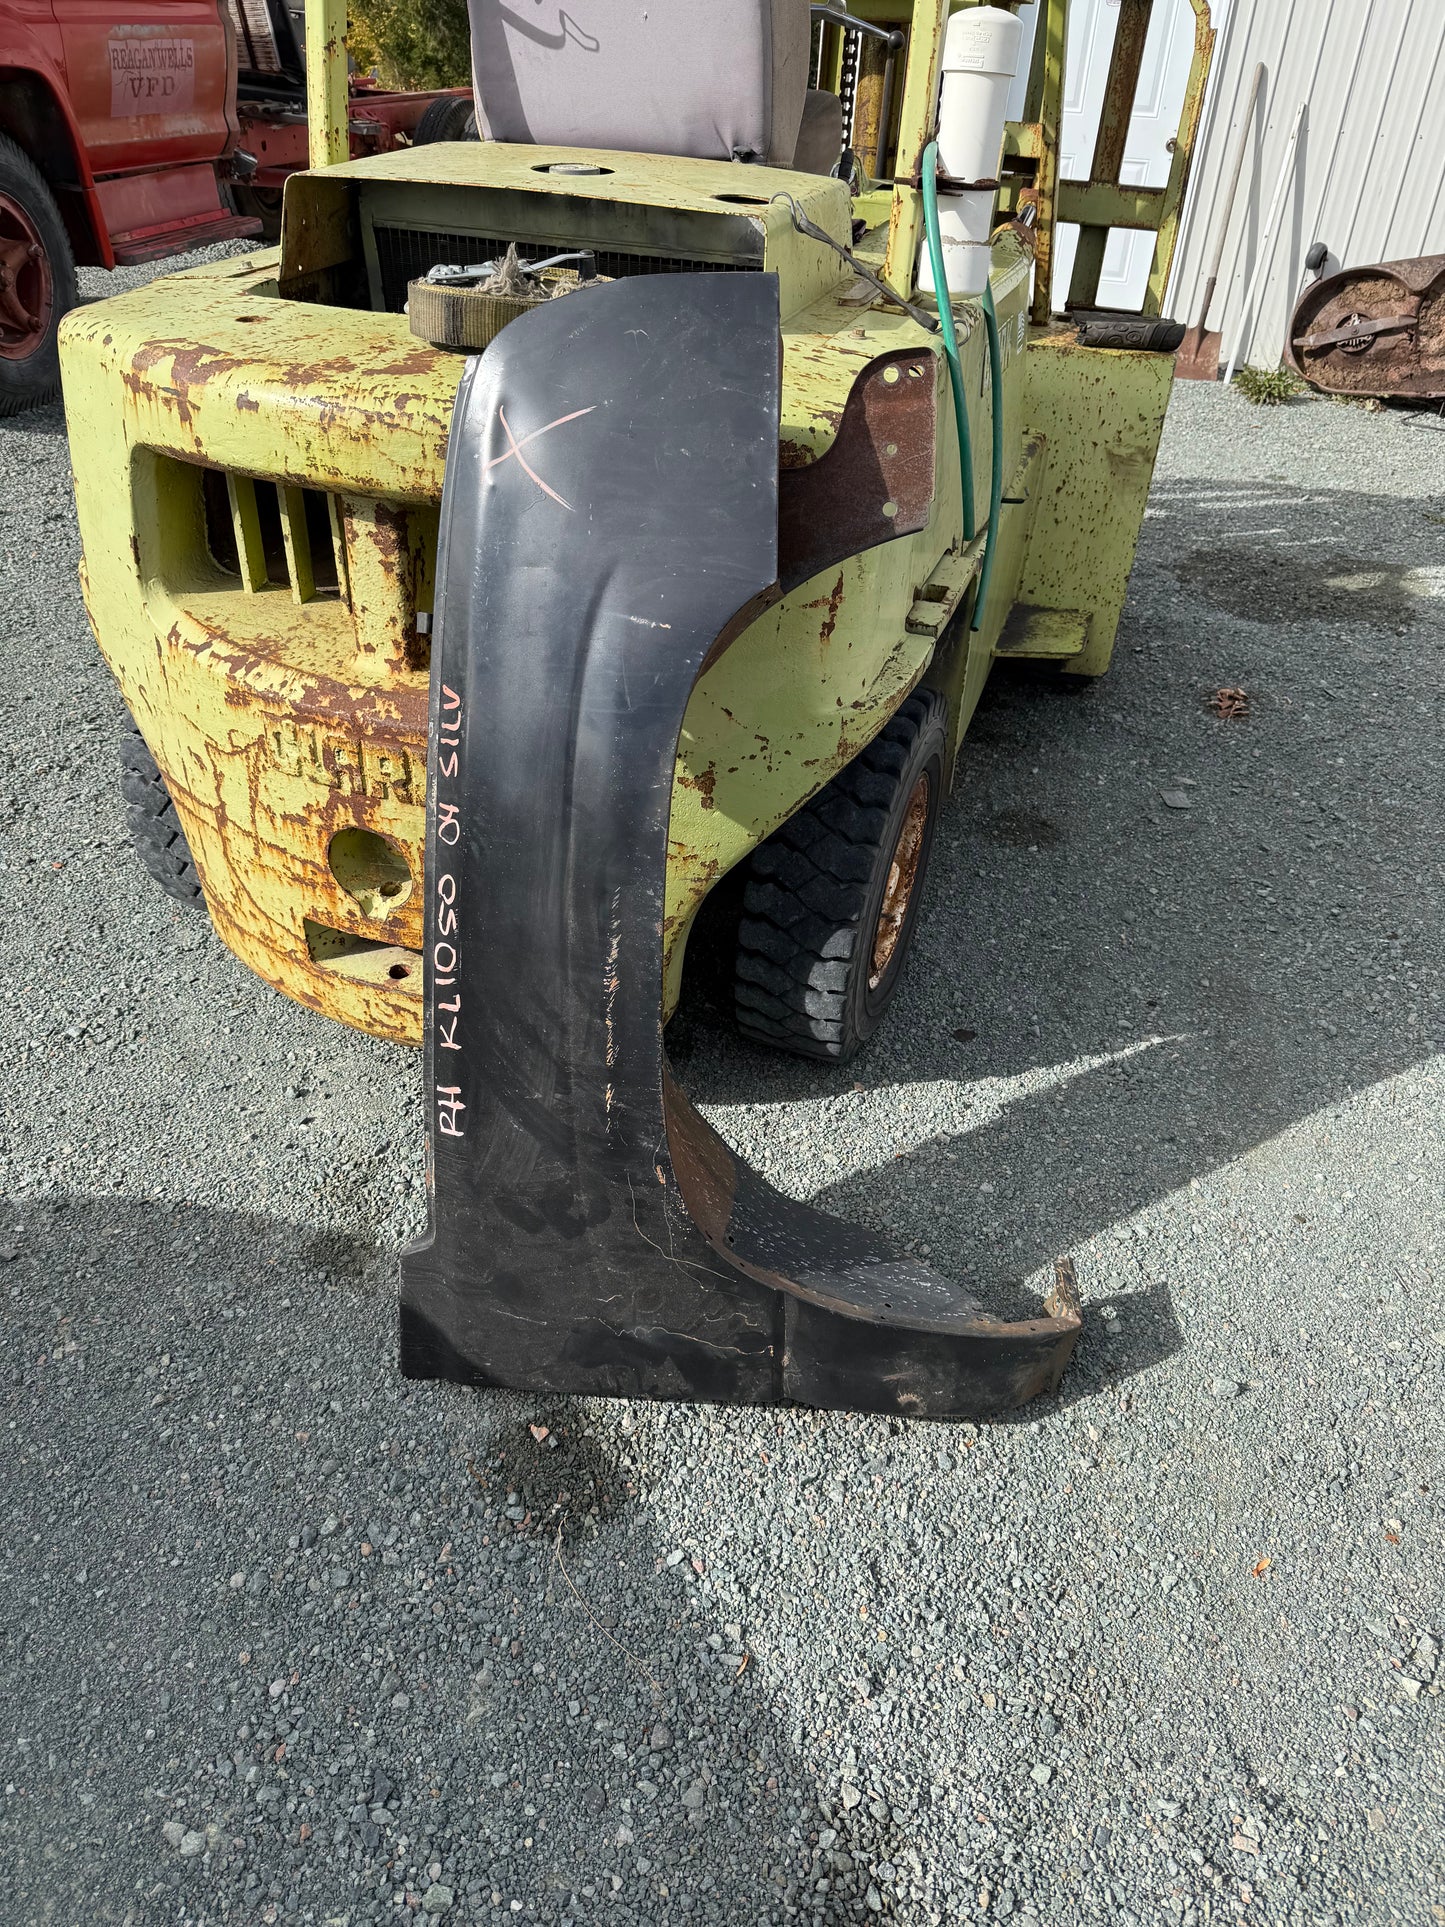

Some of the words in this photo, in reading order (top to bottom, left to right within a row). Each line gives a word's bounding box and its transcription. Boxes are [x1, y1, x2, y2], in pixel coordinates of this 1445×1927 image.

[129, 76, 175, 98] VFD
[439, 684, 461, 777] SILV
[438, 802, 460, 845] 04
[436, 1084, 467, 1137] RH
